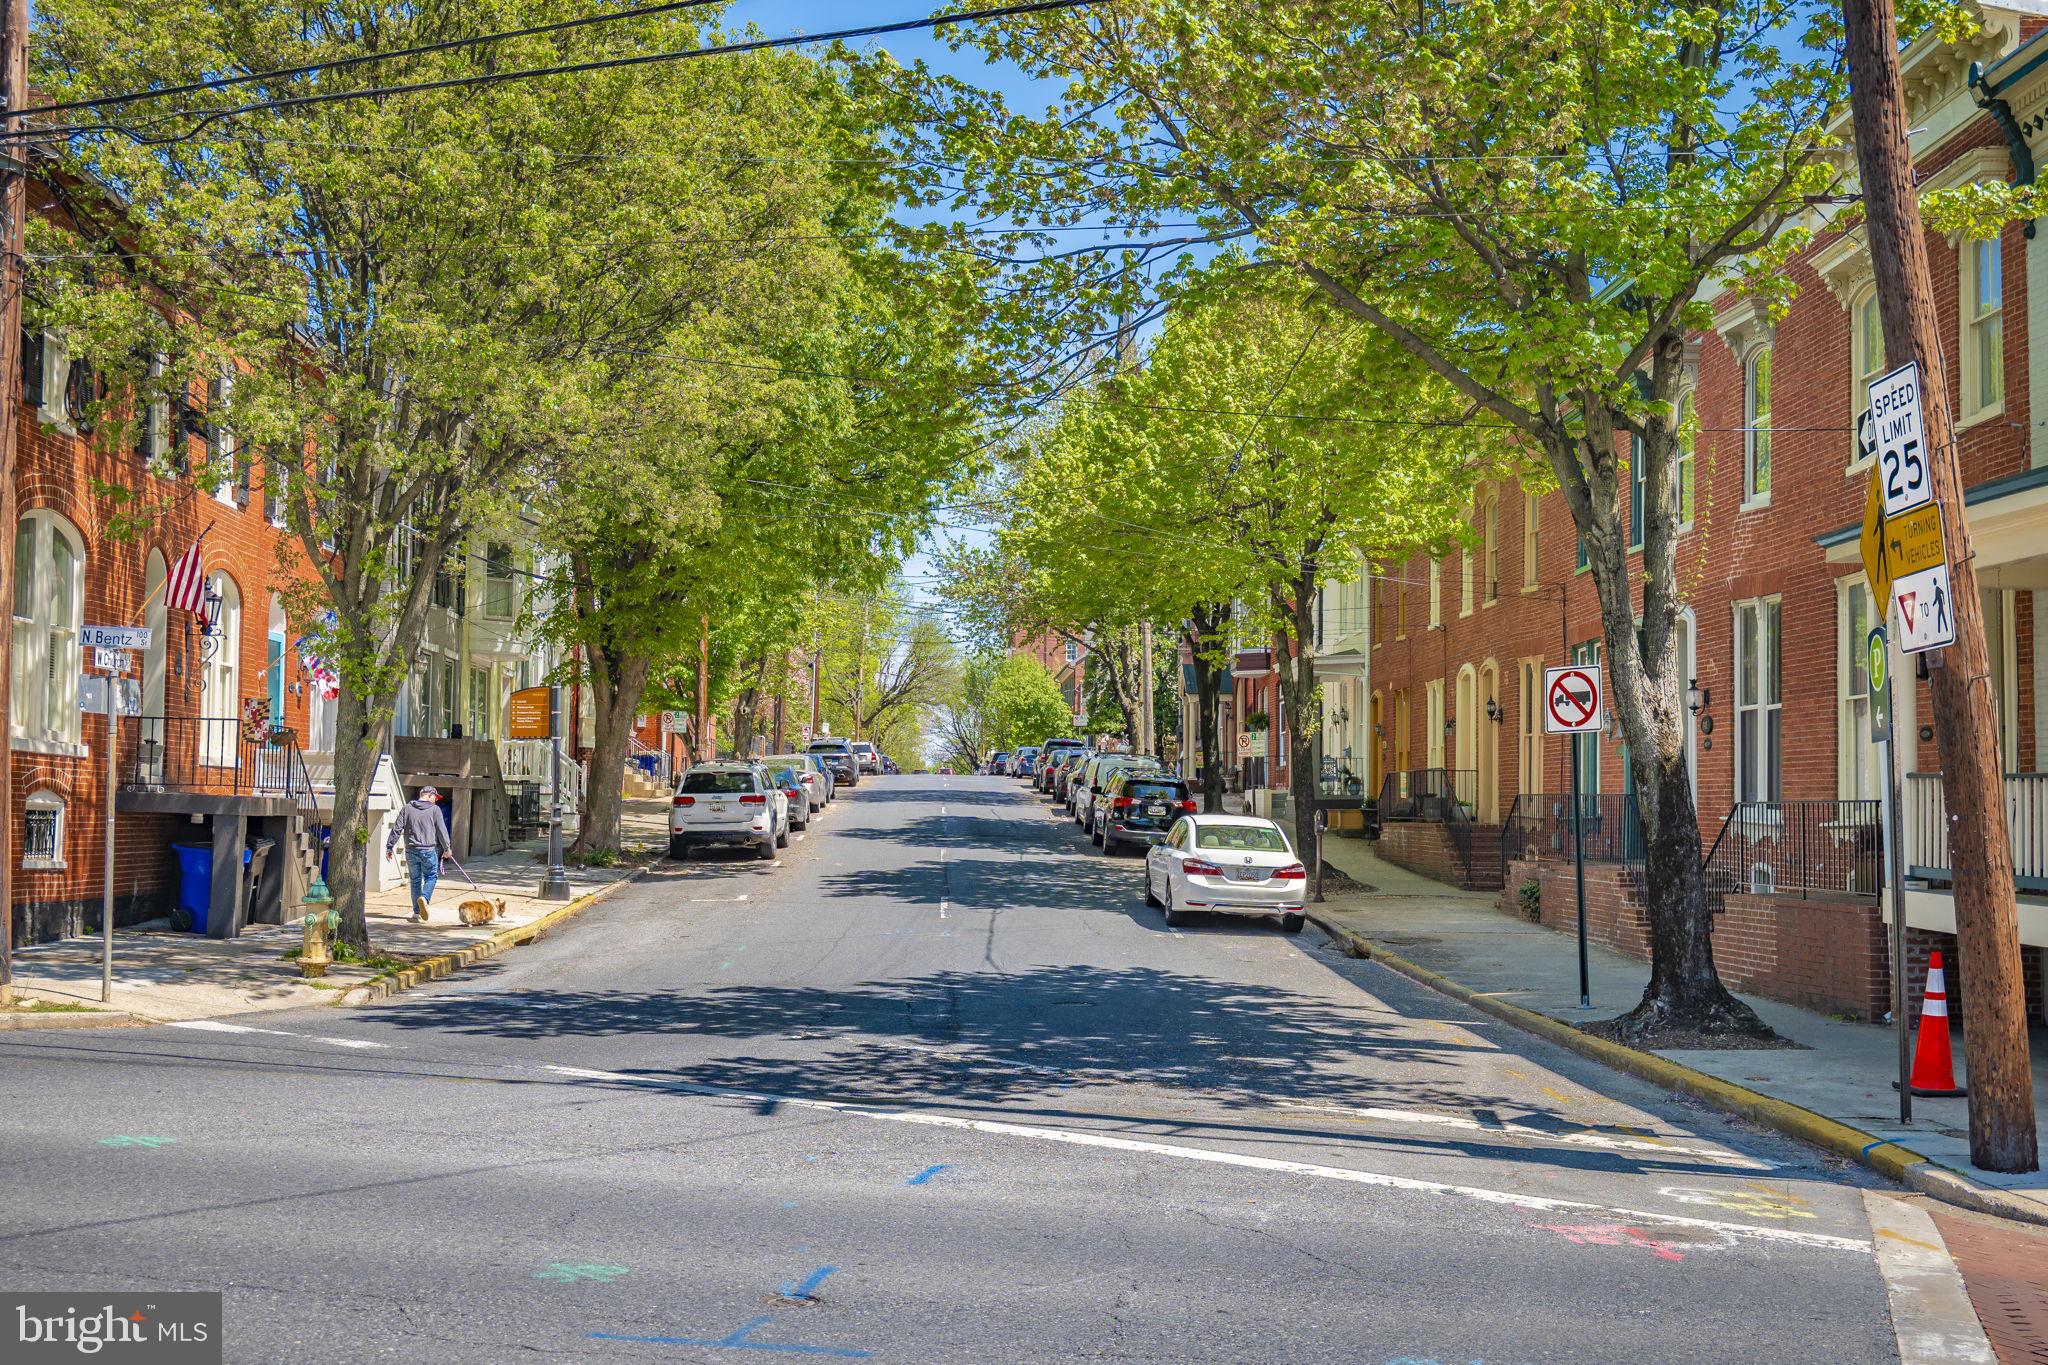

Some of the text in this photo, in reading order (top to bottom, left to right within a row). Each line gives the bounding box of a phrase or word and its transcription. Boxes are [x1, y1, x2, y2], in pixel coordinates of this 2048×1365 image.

[1875, 383, 1914, 418] SPEED
[1882, 412, 1912, 444] LIMIT
[1883, 439, 1923, 500] 25
[1903, 515, 1937, 540] TURNING
[1905, 540, 1941, 565] VEHICLES
[1920, 602, 1930, 619] TO
[82, 630, 133, 646] N. Bentz
[136, 631, 148, 639] 100
[1873, 647, 1881, 678] P
